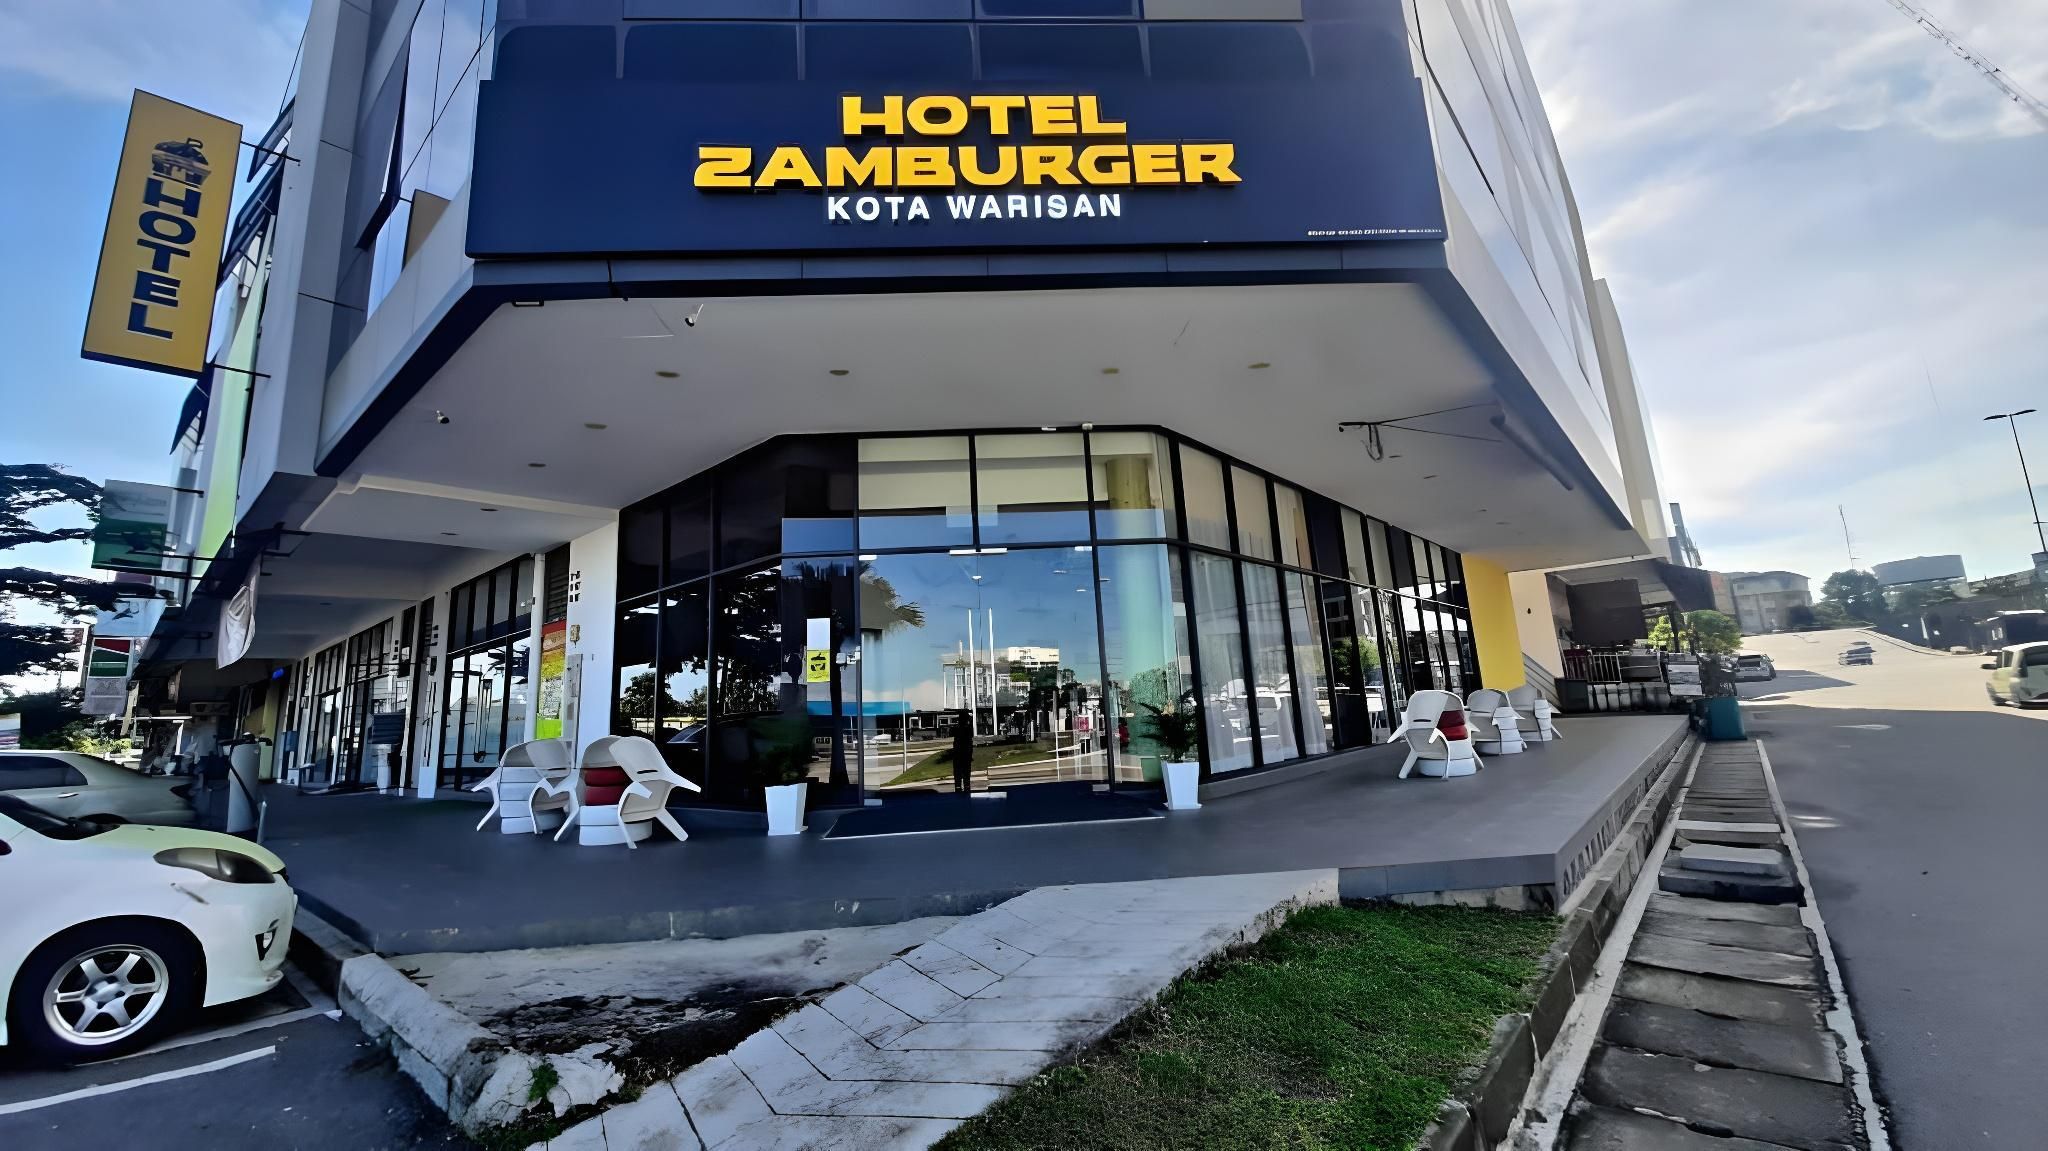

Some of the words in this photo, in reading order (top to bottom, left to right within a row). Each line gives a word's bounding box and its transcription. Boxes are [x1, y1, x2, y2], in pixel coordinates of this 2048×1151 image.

[842, 95, 1127, 136] HOTEL
[693, 143, 1243, 187] ZAMBURGER
[827, 195, 931, 221] KOTA
[946, 192, 1121, 220] WARISAN
[127, 177, 202, 340] HOTEL
